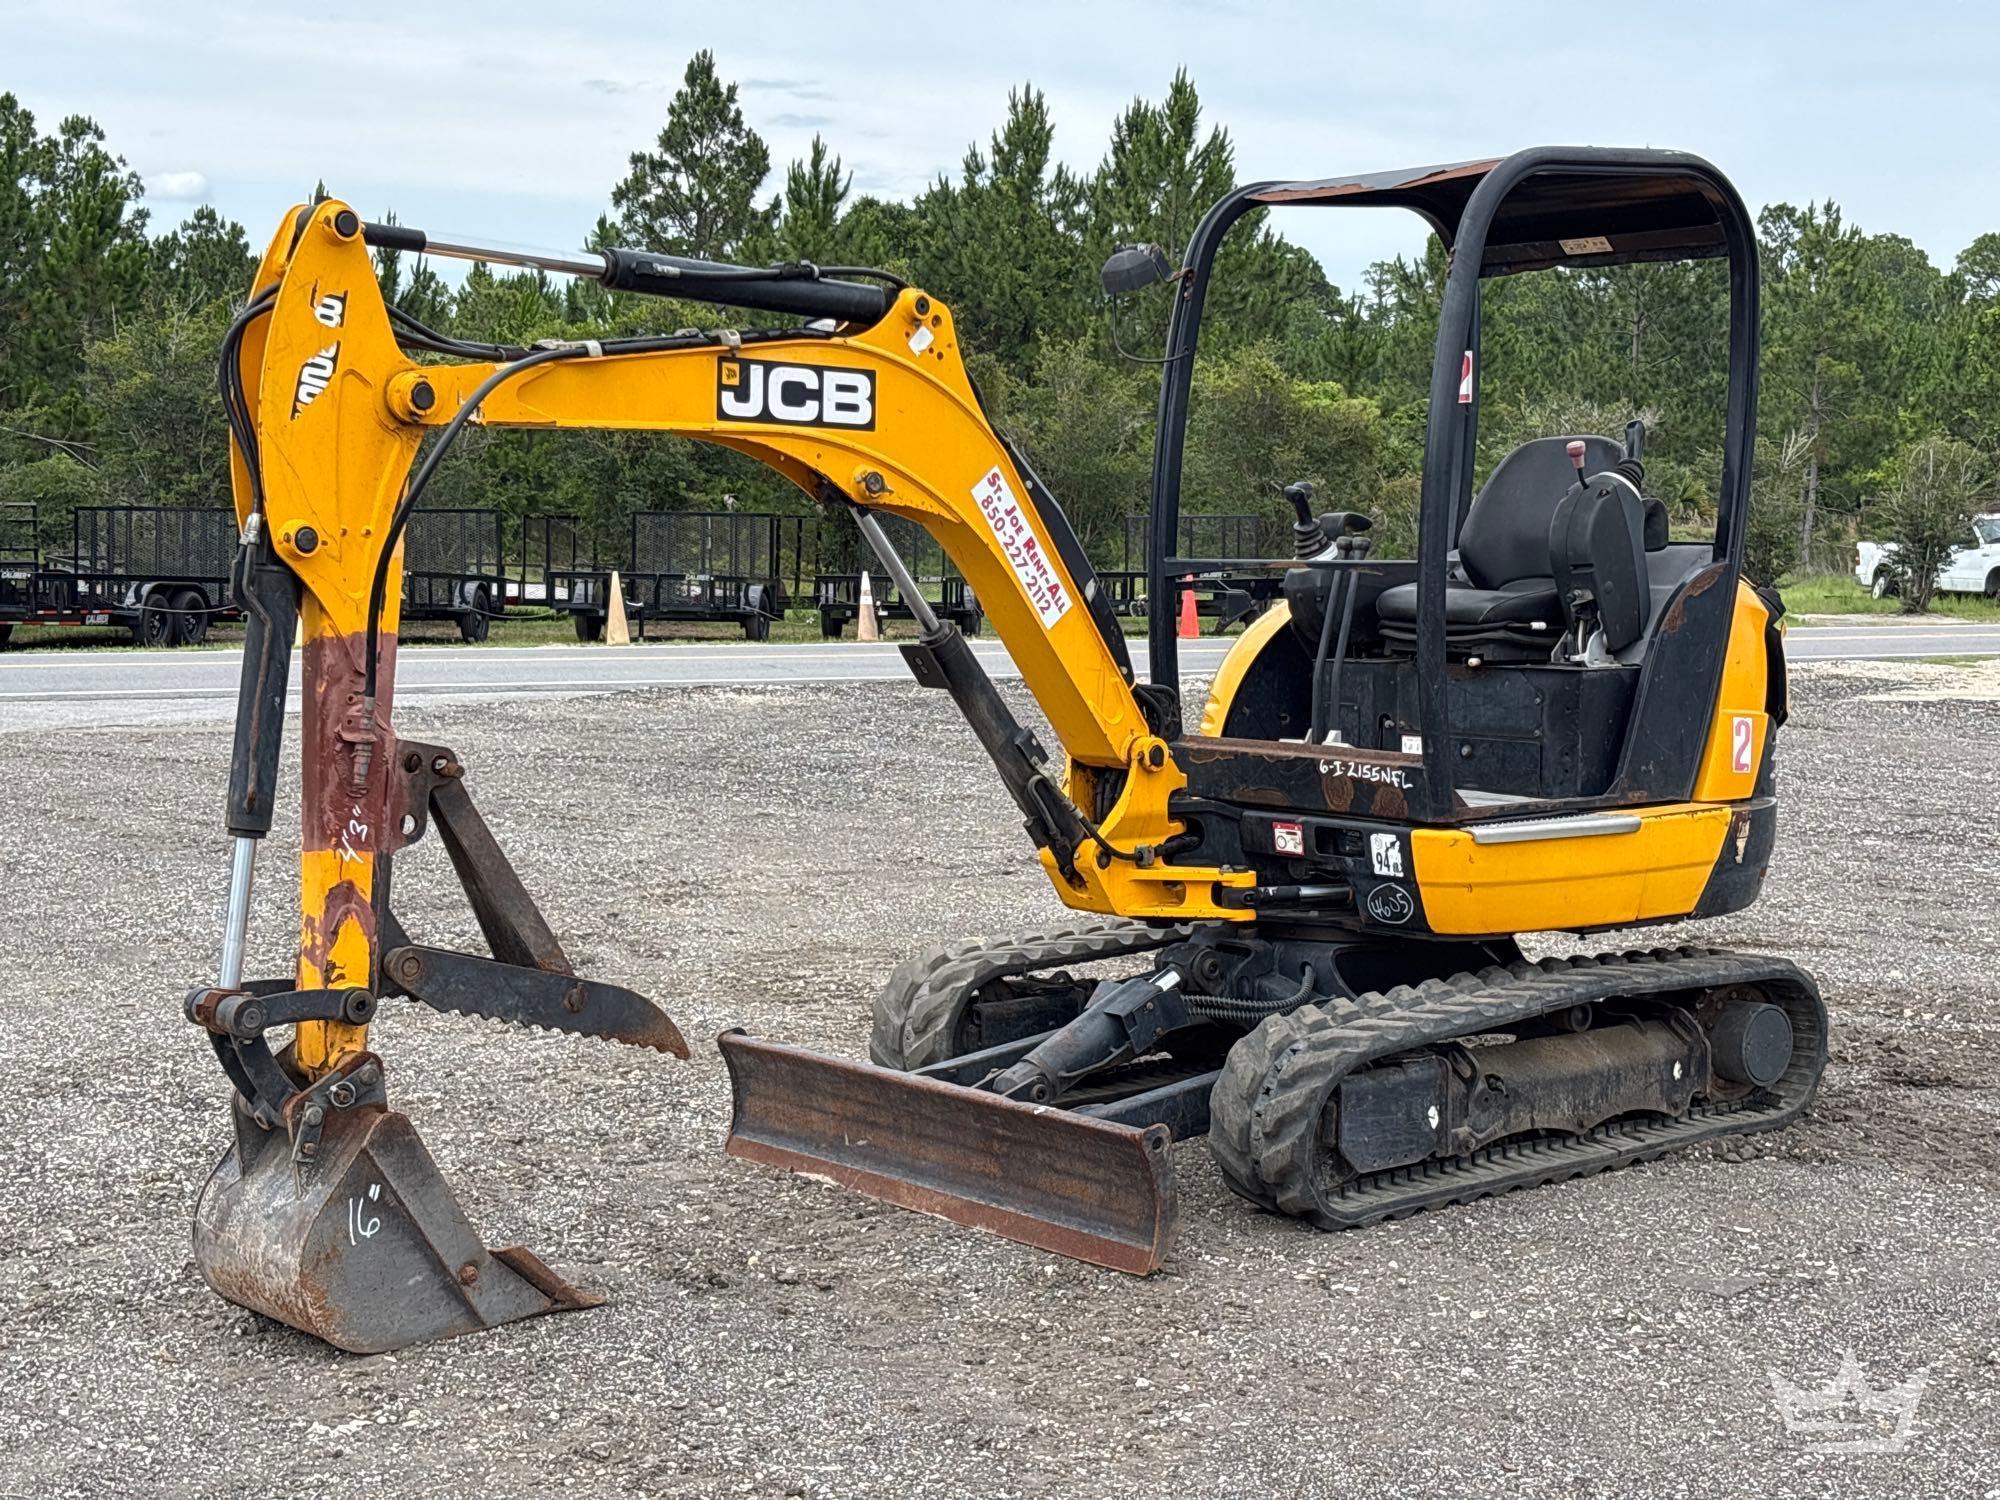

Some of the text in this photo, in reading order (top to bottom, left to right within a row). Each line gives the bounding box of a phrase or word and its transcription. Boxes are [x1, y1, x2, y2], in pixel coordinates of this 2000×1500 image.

[721, 363, 873, 425] JCB
[981, 495, 1052, 616] 850-227-2112
[1004, 505, 1025, 537] JOE
[1022, 536, 1067, 613] RENT-ALL
[1735, 719, 1751, 771] 2
[349, 1184, 382, 1247] 16"
